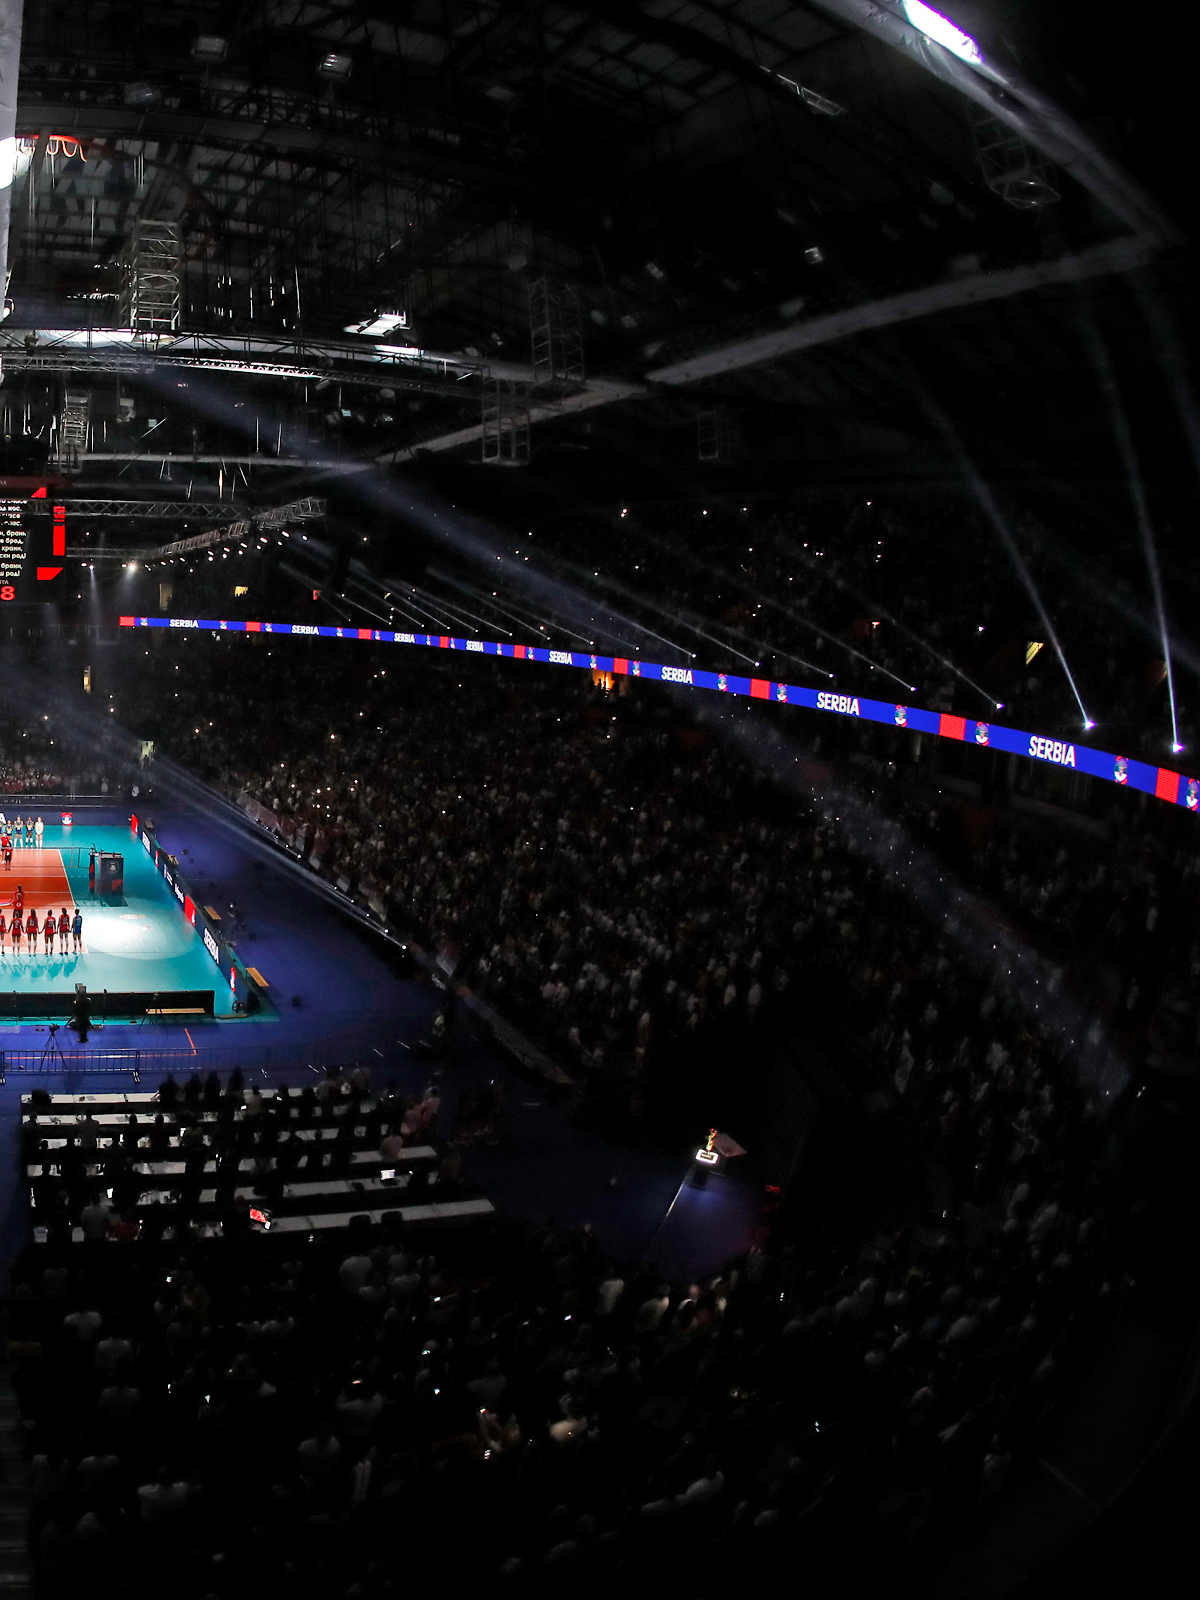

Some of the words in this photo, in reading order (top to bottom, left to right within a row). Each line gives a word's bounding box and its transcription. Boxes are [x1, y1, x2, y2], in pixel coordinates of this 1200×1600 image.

[169, 619, 199, 628] SERBIA
[291, 625, 320, 635] SERBIA
[393, 633, 415, 644] SERBIA
[466, 640, 483, 652] SERBIA
[549, 651, 573, 665] SERBIA
[661, 666, 693, 684] SERBIA
[817, 692, 860, 715] SERBIA
[1028, 736, 1076, 767] SERBIA
